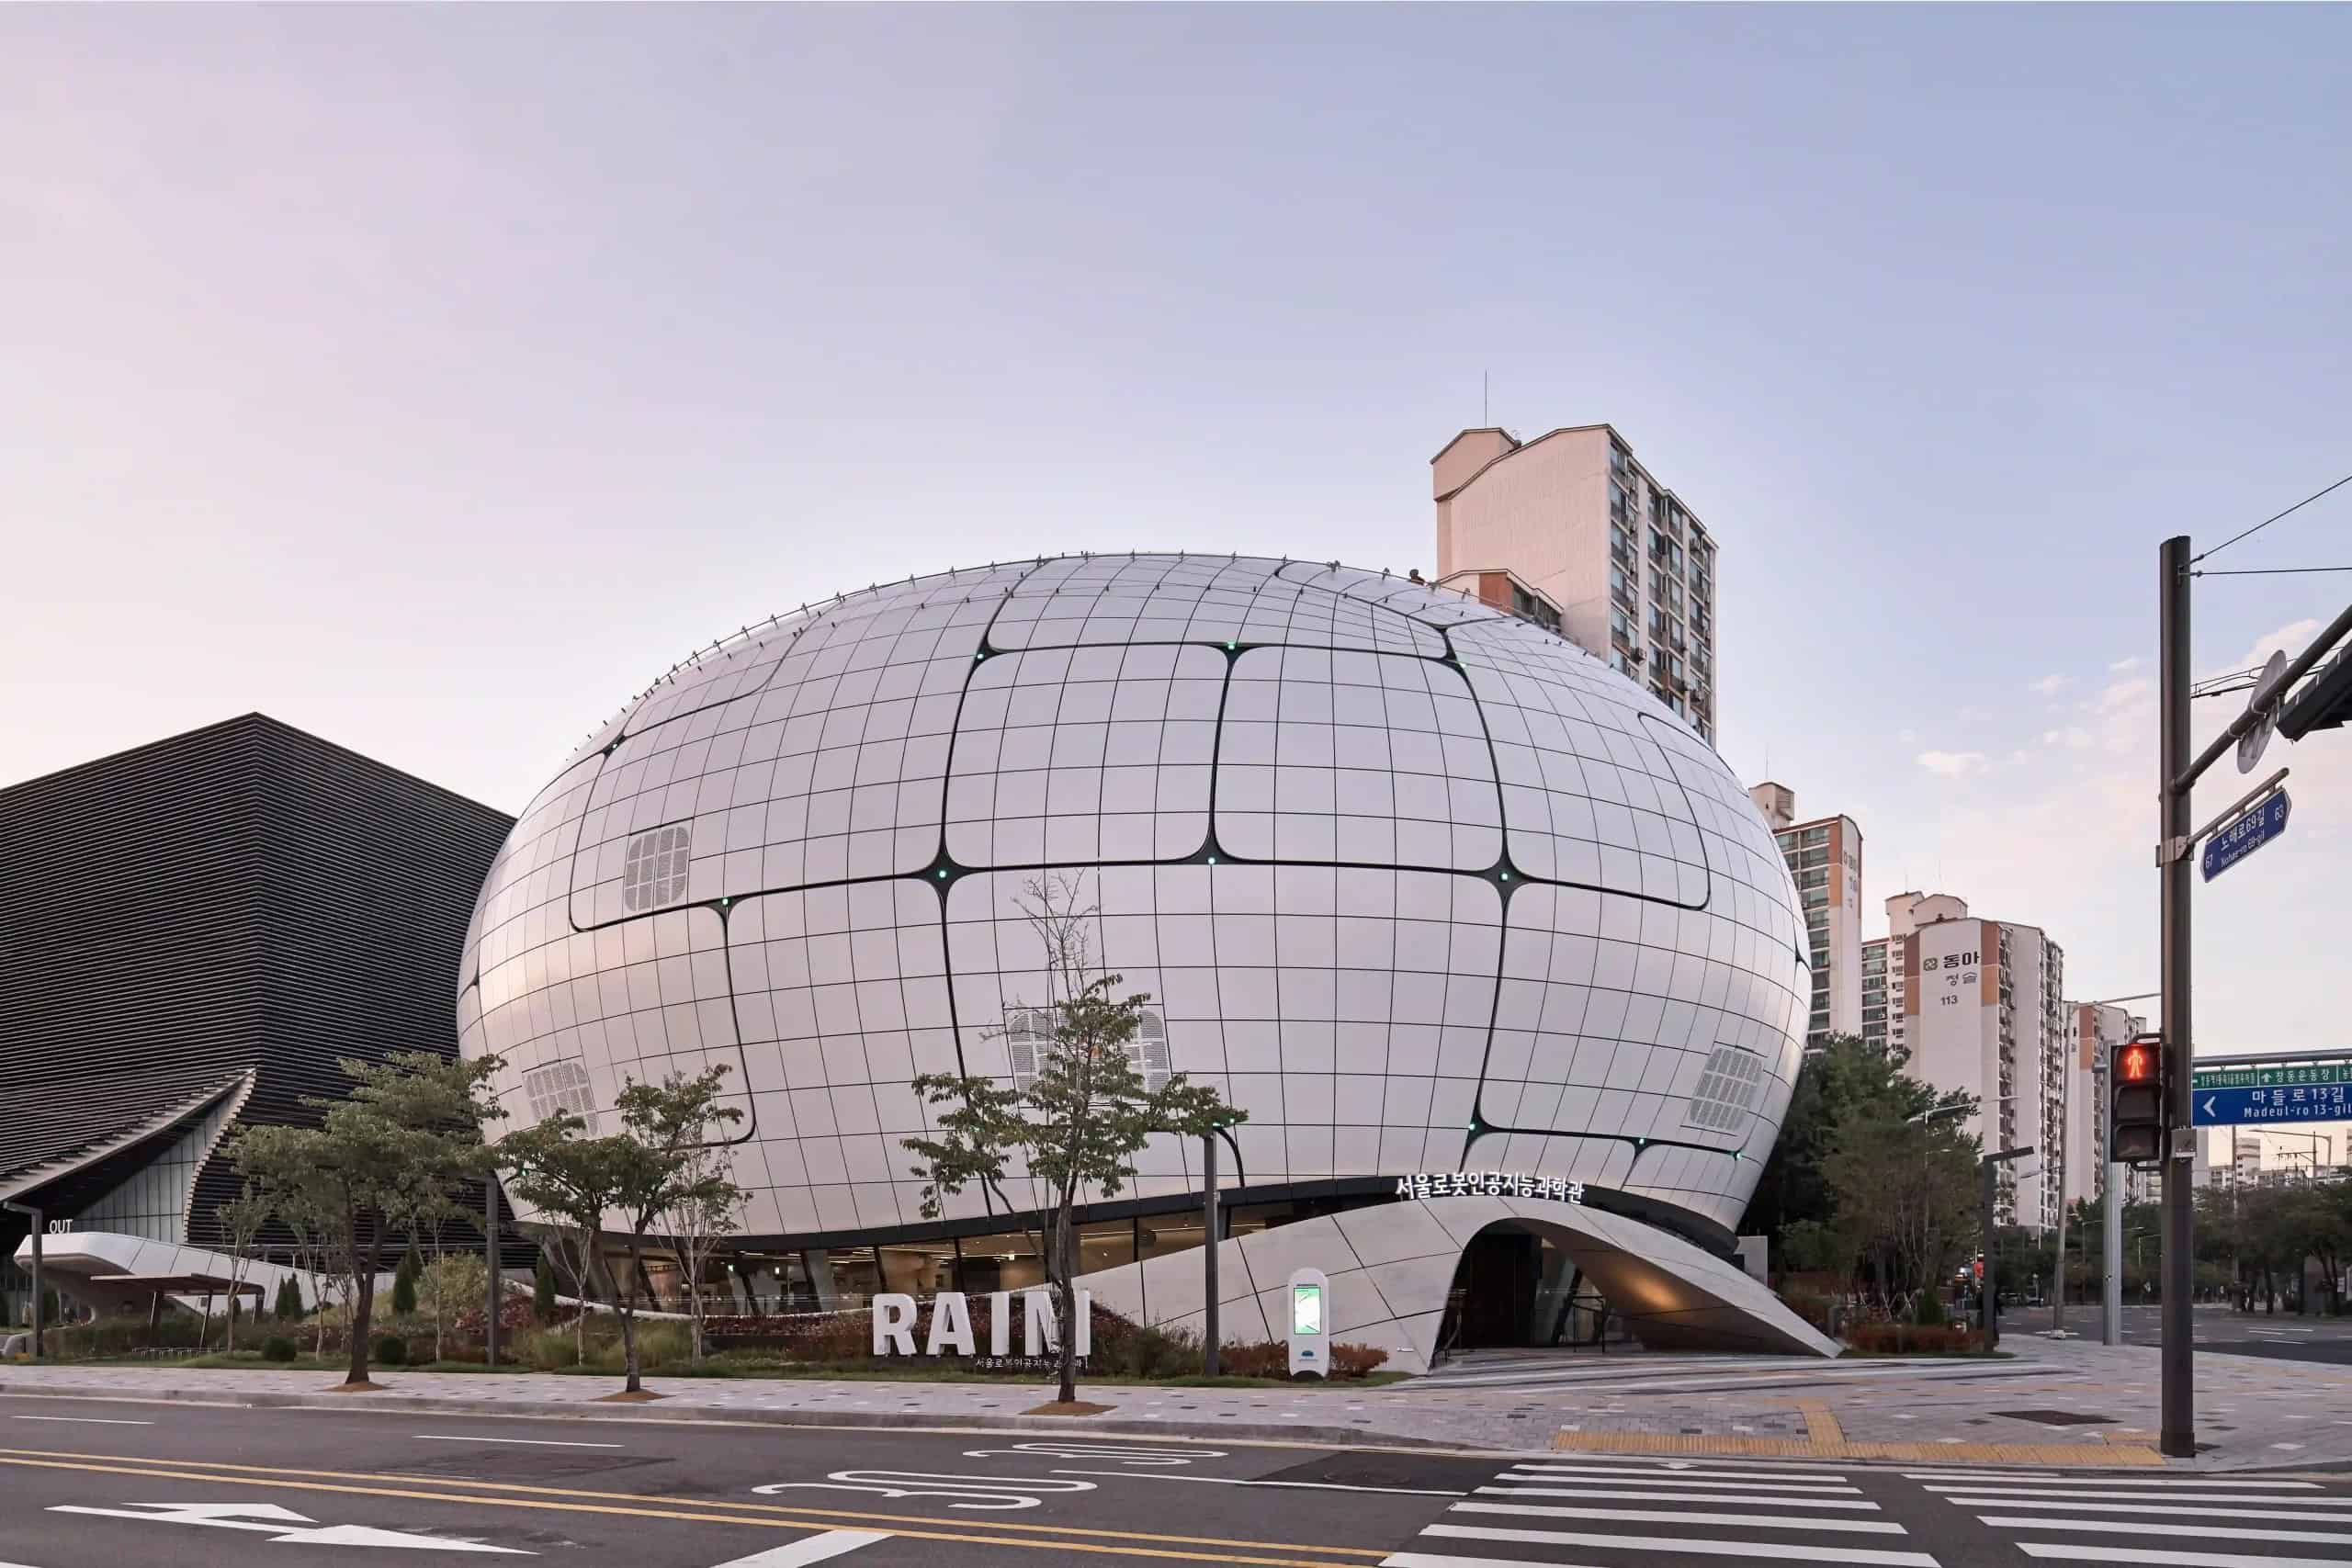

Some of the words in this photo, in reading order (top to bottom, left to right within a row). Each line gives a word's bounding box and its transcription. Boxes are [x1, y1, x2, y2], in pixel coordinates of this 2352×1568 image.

[1941, 995, 1958, 1006] 113
[2244, 1105, 2309, 1118] Madeul-ro
[2313, 1102, 2352, 1116] 13-gil
[1395, 1170, 1585, 1204] 서울로봇인공지능과학관
[50, 1219, 74, 1234] OUT
